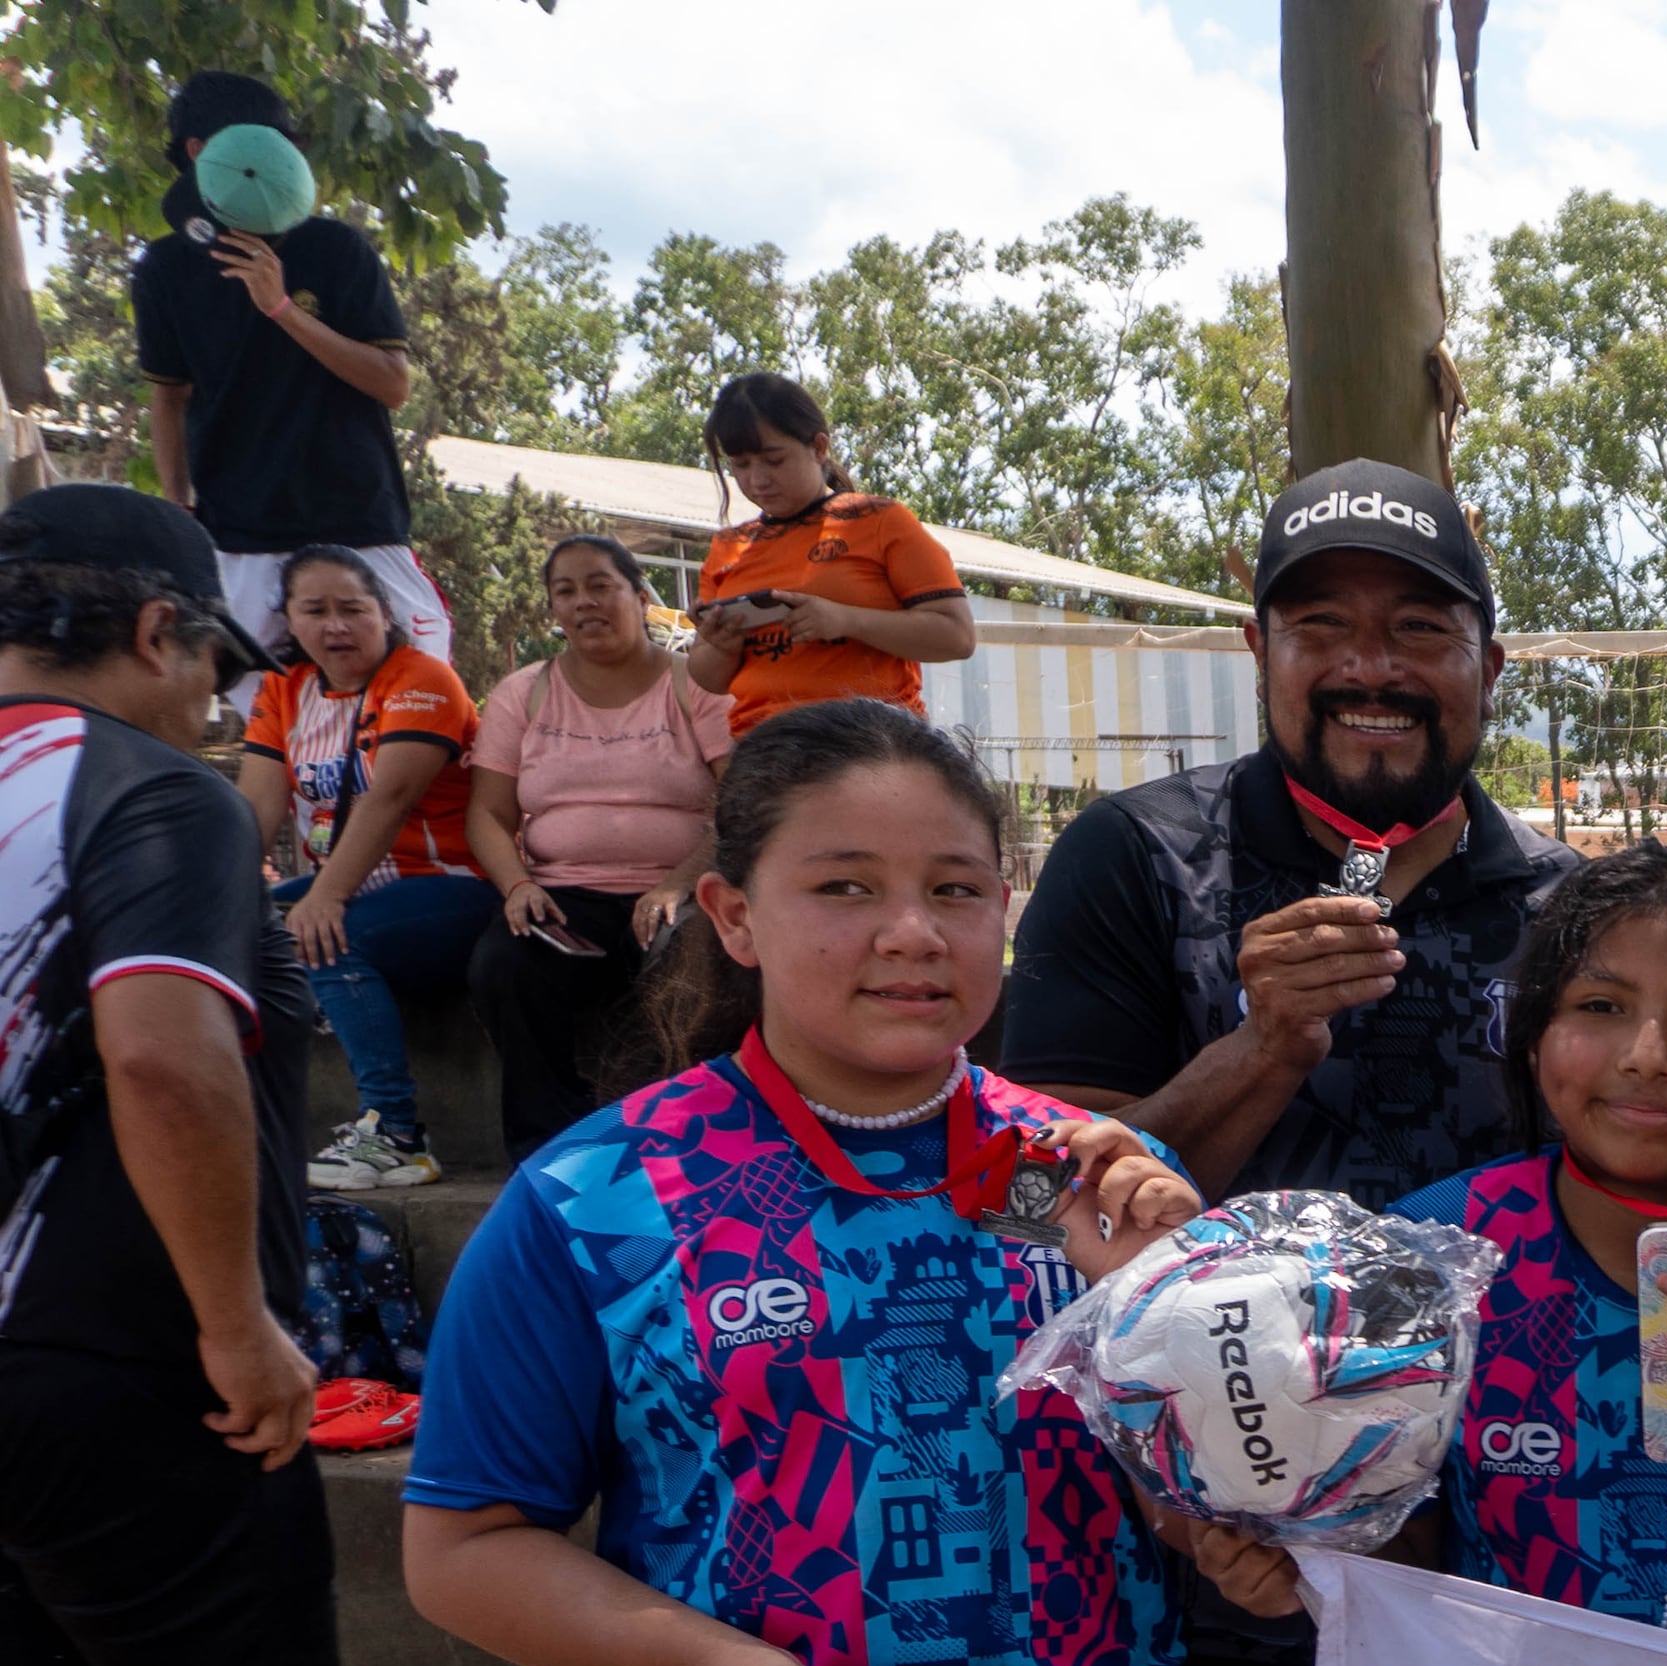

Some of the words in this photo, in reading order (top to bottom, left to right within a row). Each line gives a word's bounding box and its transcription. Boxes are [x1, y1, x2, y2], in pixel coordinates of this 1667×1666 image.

[1283, 490, 1439, 539] adidas
[715, 1319, 815, 1349] mambore
[1209, 1298, 1295, 1489] Reebok
[1480, 1460, 1562, 1477] mambore
